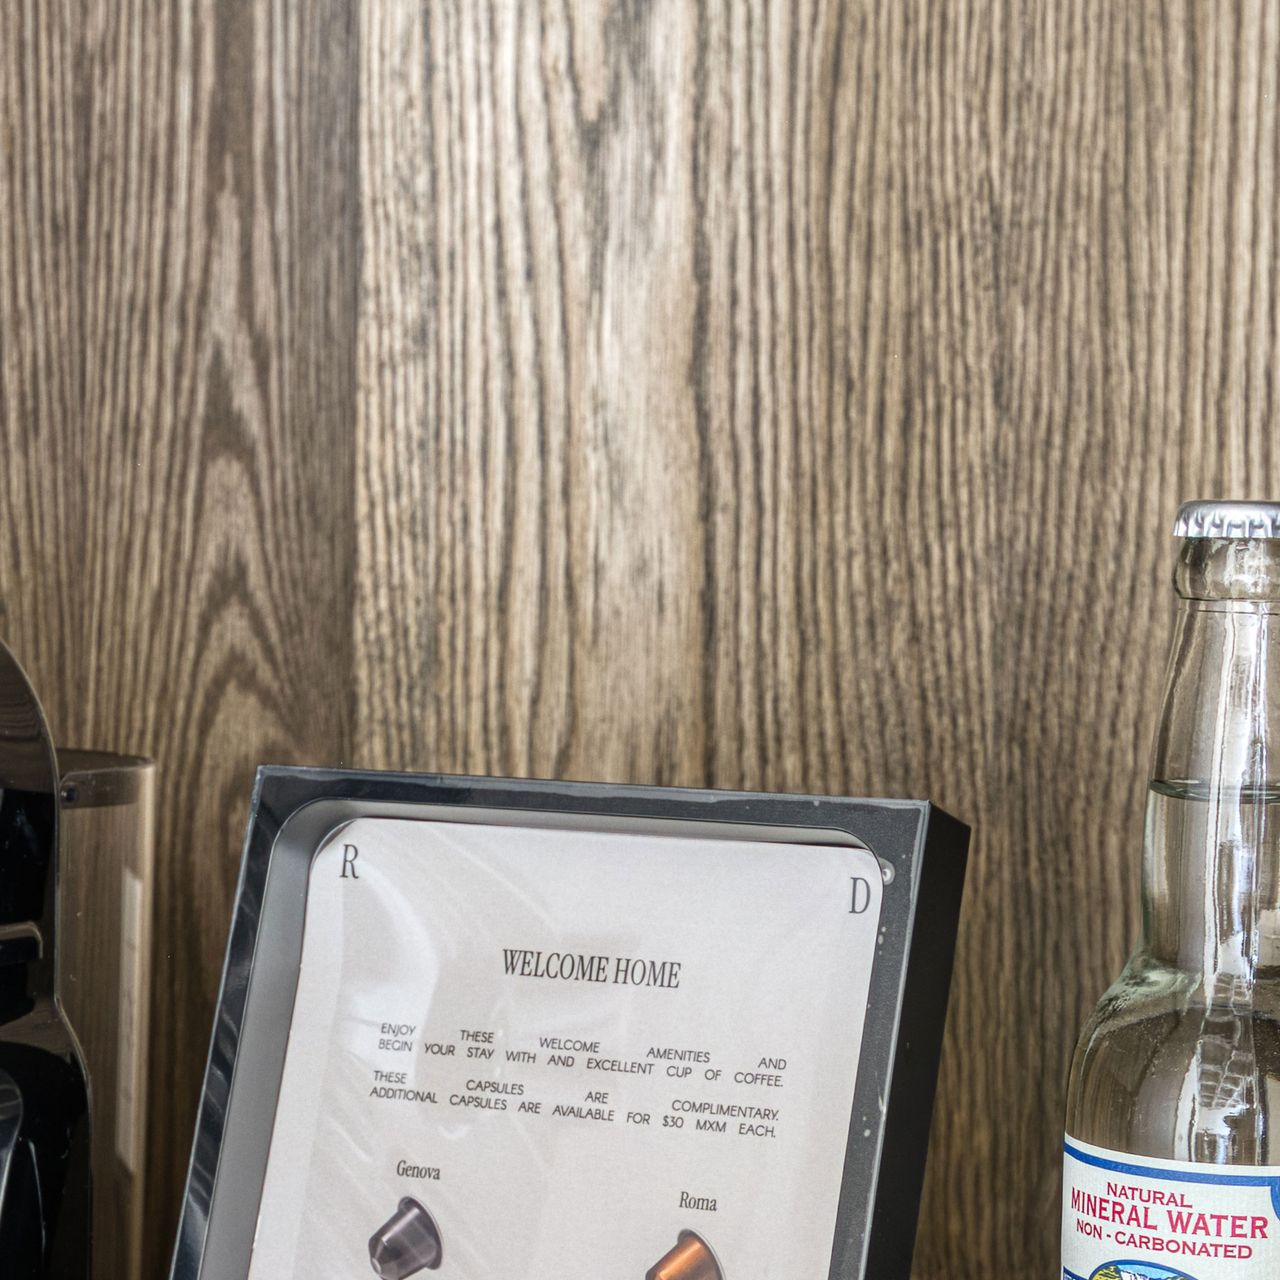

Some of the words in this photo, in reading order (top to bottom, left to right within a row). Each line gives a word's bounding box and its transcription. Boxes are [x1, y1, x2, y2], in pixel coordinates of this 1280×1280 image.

[339, 844, 359, 879] R
[849, 877, 871, 914] D
[503, 949, 608, 984] WELCOME
[613, 959, 681, 989] HOME
[378, 1038, 413, 1051] BEGIN
[424, 1043, 456, 1056] YOUR
[466, 1046, 495, 1060] STAY
[505, 1050, 537, 1064] WITH
[547, 1055, 575, 1067] AND
[586, 1058, 655, 1075] EXCELLENT
[666, 1065, 692, 1078] CUP
[704, 1069, 722, 1081] OF
[734, 1072, 784, 1087] COFFEE.
[380, 1023, 416, 1036] ENJOY
[460, 1029, 495, 1043] THESE
[539, 1037, 600, 1053] WELCOME
[646, 1047, 711, 1063] AMENITIES
[758, 1057, 787, 1070] AND
[370, 1087, 438, 1104] ADDITIONAL
[449, 1094, 507, 1110] CAPSULES
[517, 1102, 542, 1114] ARE
[552, 1105, 614, 1122] AVAILABLE
[627, 1112, 651, 1125] FOR
[662, 1115, 684, 1129] $30
[695, 1119, 727, 1133] MXM
[739, 1123, 776, 1138] EACH.
[374, 1070, 407, 1084] THESE
[466, 1079, 525, 1095] CAPSULES
[584, 1091, 609, 1104] ARE
[672, 1099, 779, 1121] COMPLIMENTARY.
[396, 1159, 441, 1181] Genova
[678, 1190, 718, 1213] Roma
[1071, 1187, 1158, 1231] MINERAL
[1166, 1210, 1269, 1239] WATER
[1107, 1182, 1193, 1208] NATURAL
[1076, 1219, 1102, 1240] NON
[1114, 1231, 1253, 1259] CARBONATED
